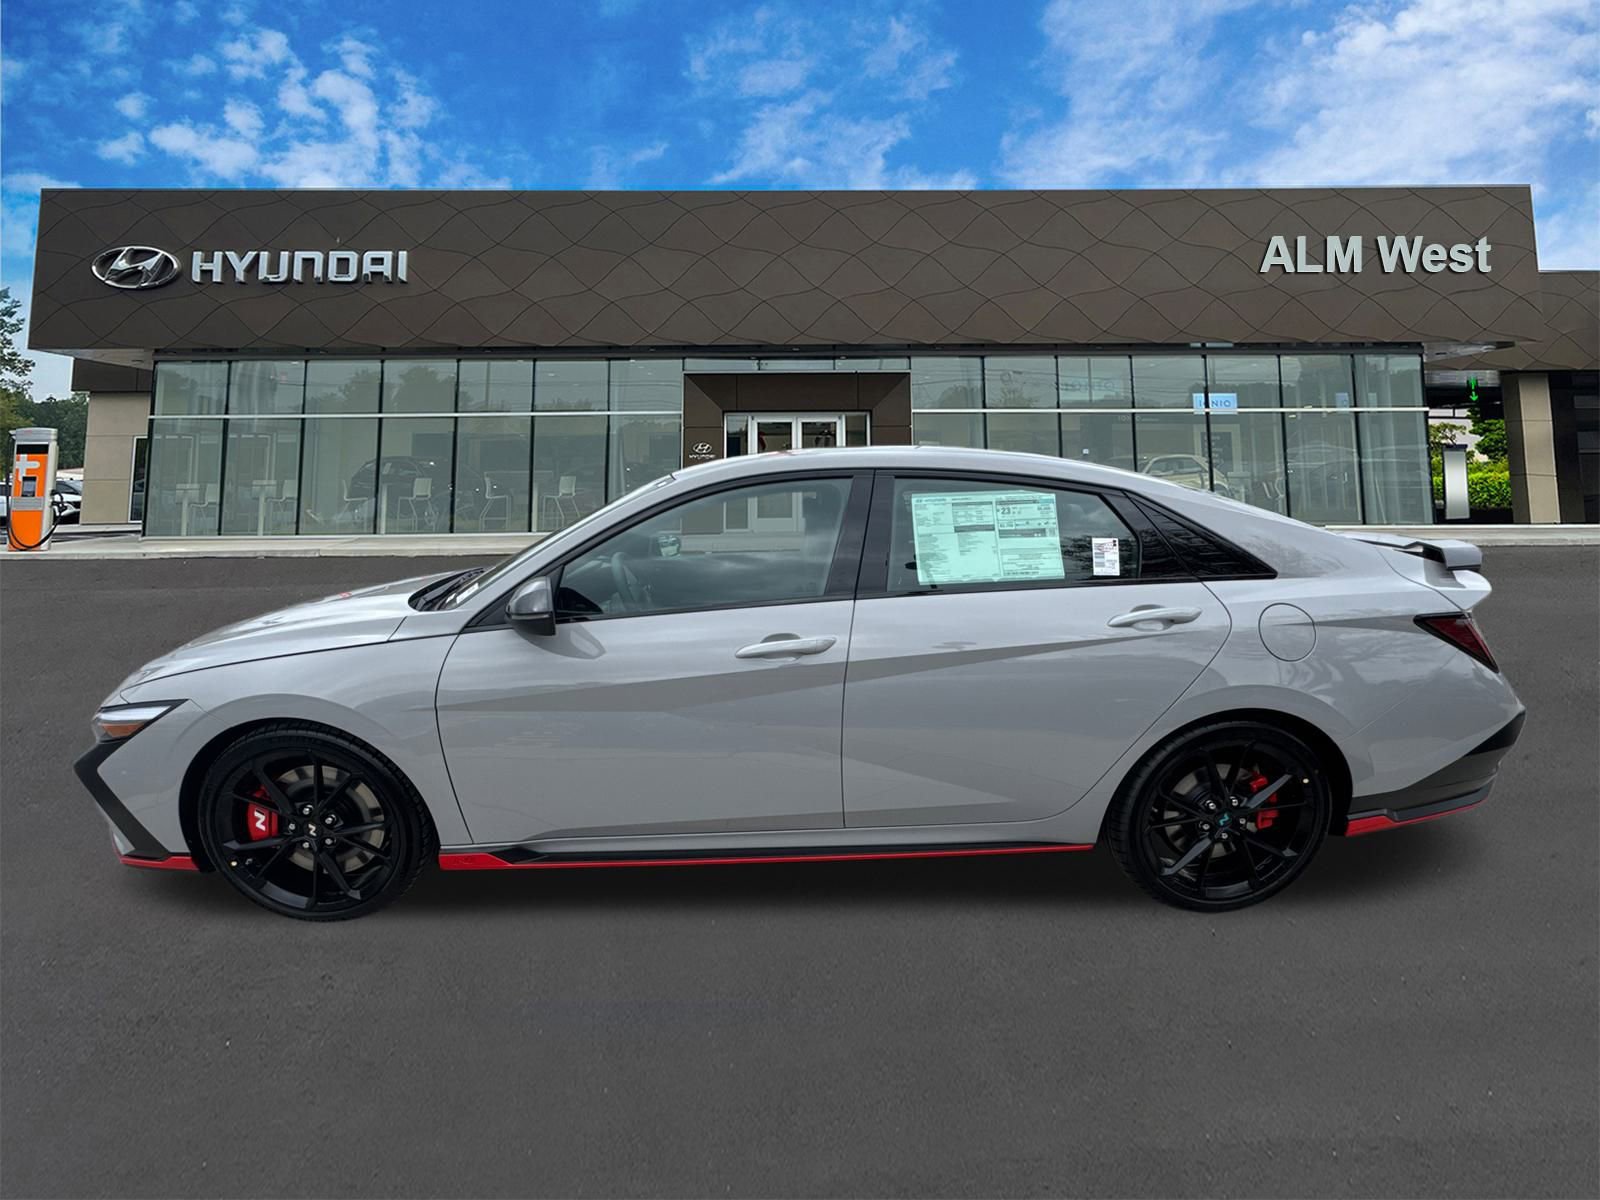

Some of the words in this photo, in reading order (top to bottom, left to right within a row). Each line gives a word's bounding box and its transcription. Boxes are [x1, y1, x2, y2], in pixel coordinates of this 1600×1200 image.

[192, 250, 408, 284] HYUNDAI
[1259, 235, 1363, 274] ALM
[1376, 235, 1493, 274] West
